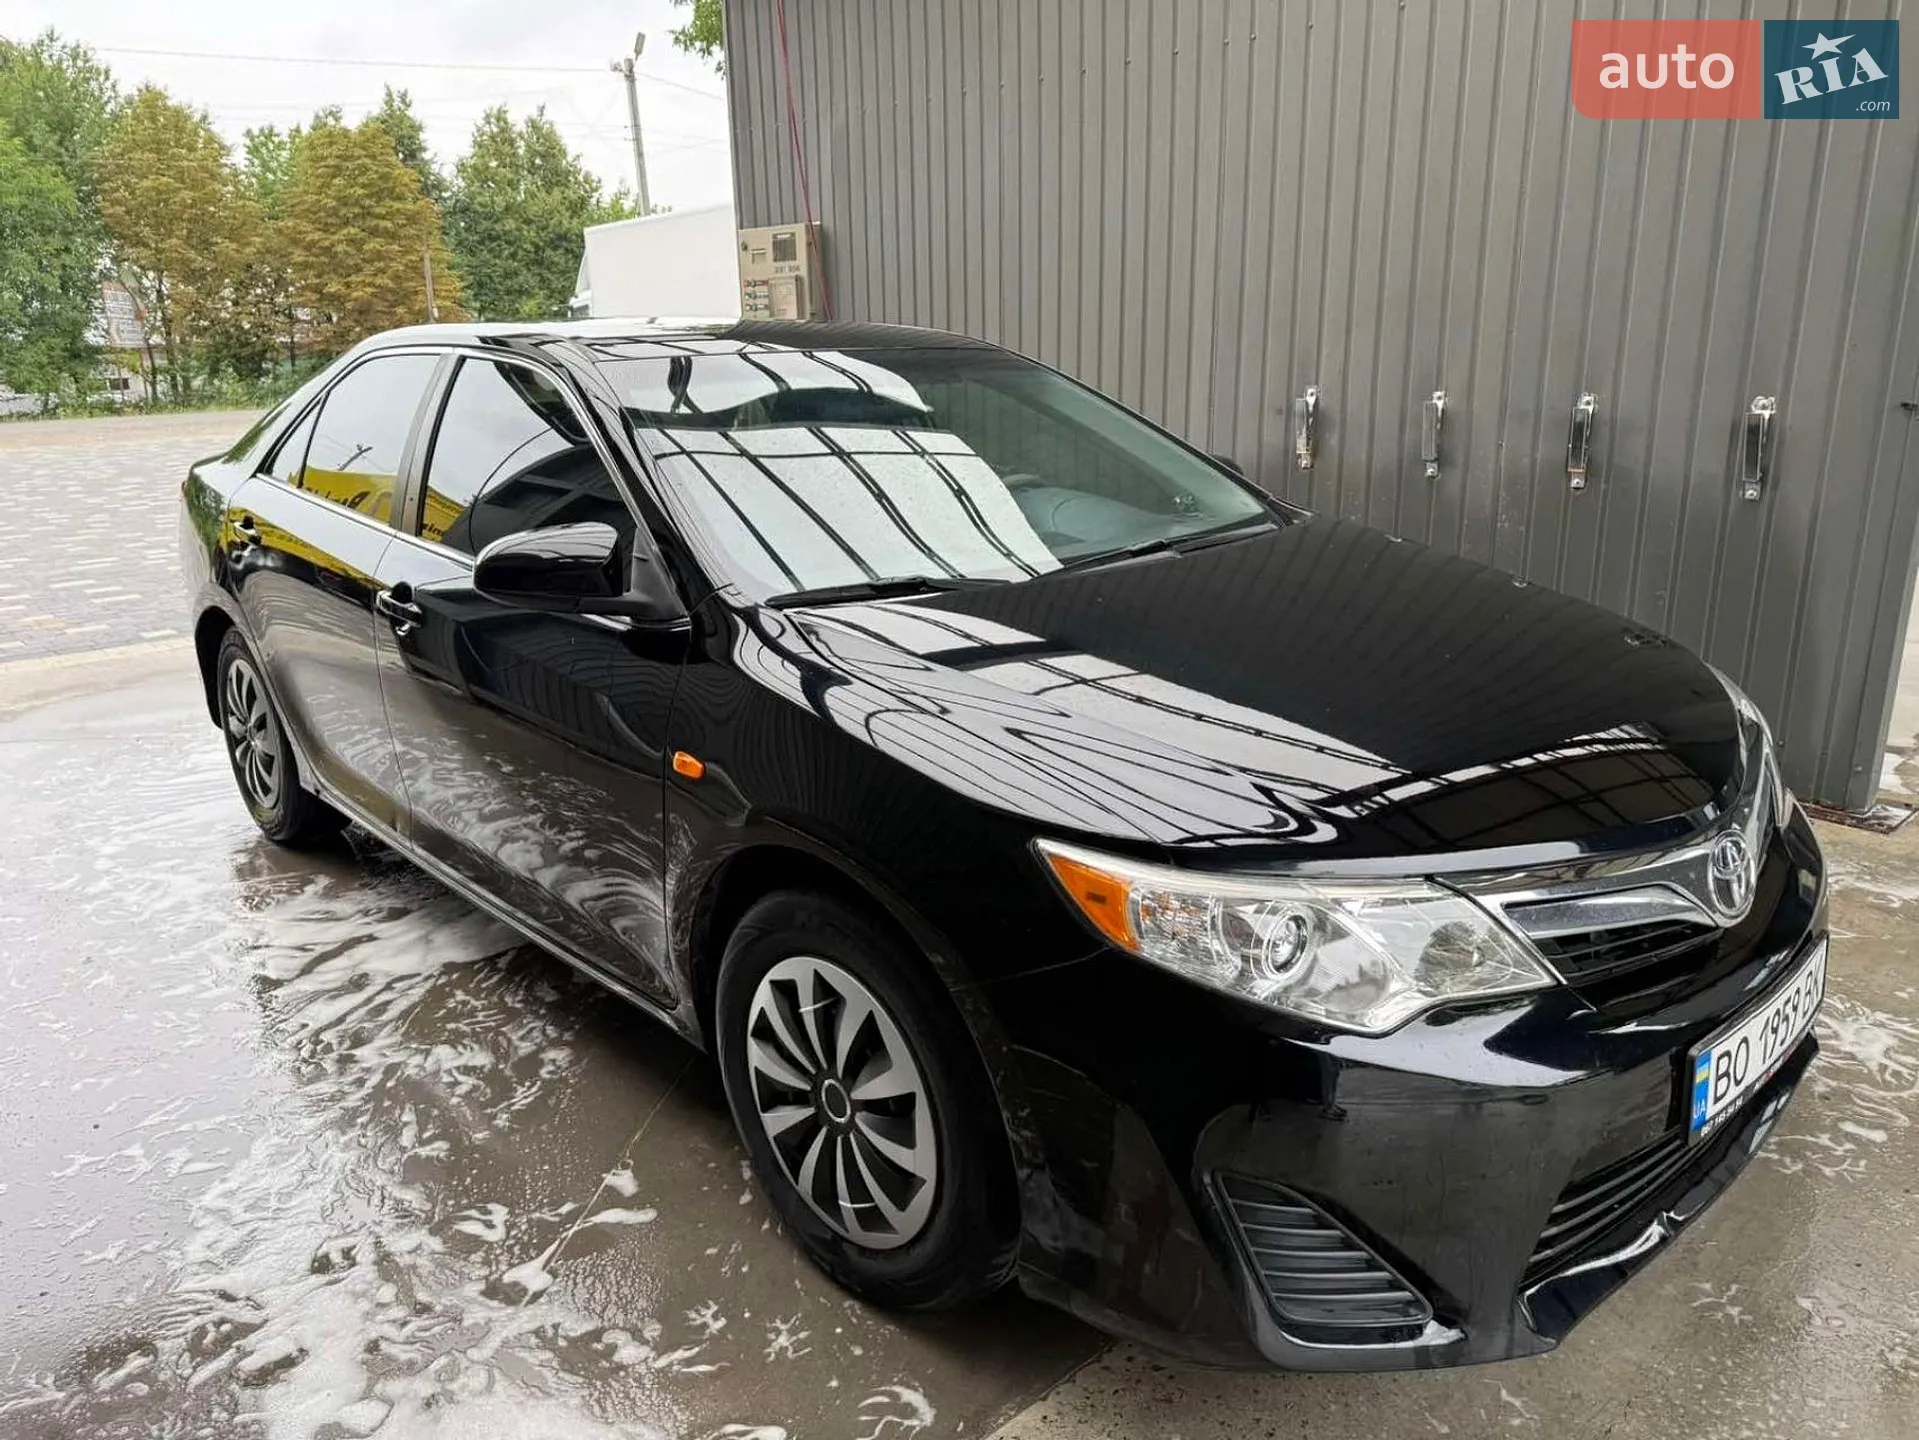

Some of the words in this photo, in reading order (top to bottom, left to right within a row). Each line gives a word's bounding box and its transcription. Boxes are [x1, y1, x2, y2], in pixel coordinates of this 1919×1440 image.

[1714, 1037, 1750, 1104] BO
[1759, 987, 1801, 1065] 1959
[1692, 1098, 1707, 1119] UA
